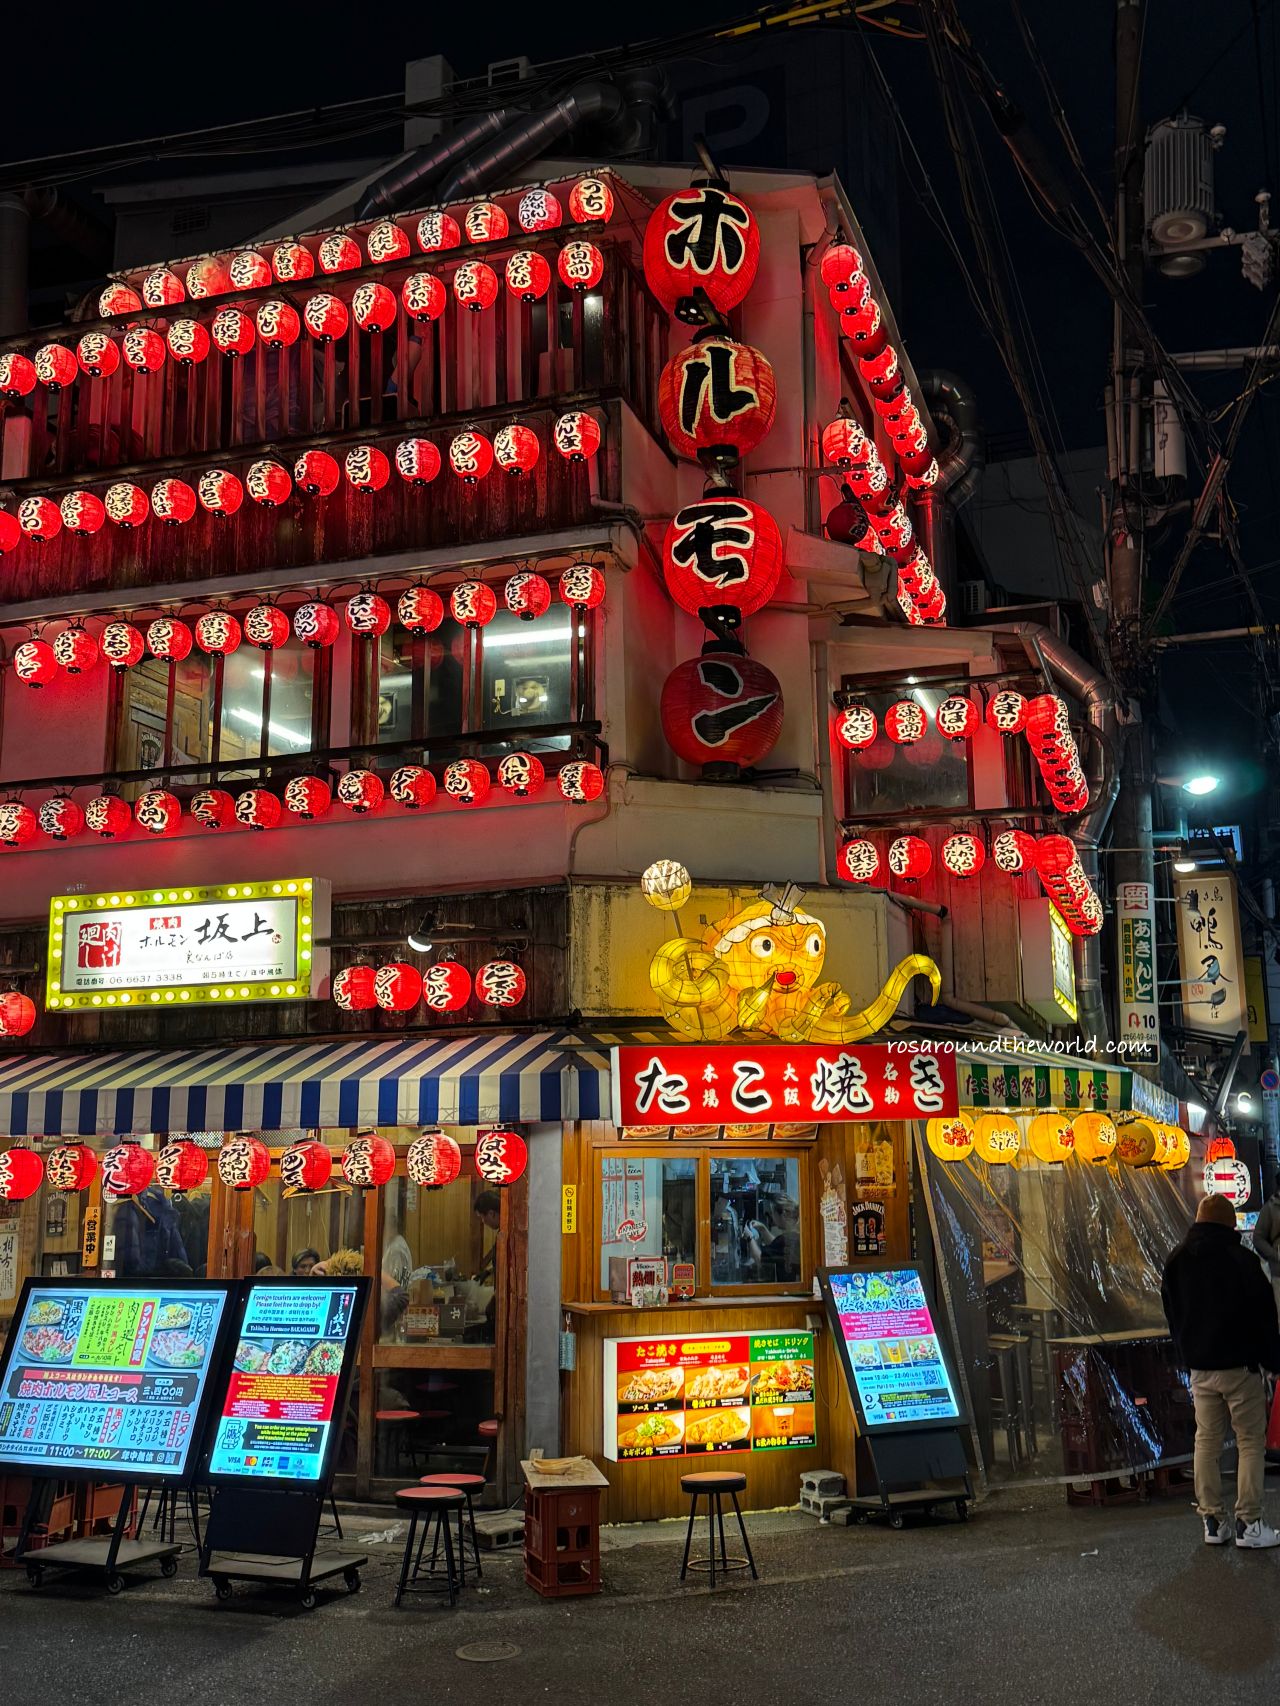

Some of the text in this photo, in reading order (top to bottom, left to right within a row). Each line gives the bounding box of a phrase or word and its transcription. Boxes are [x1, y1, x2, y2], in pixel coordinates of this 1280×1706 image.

[582, 180, 606, 213] うち
[939, 697, 968, 734] あほか
[1123, 886, 1149, 911] 質
[102, 922, 123, 967] 肉汁
[139, 934, 190, 949] ホルモン
[194, 912, 275, 945] 坂上
[1133, 920, 1153, 1001] あきんど
[109, 973, 183, 985] 06 6637 3338
[1143, 1014, 1156, 1029] 10
[634, 1052, 945, 1114] たこ焼き
[702, 1063, 720, 1108] 本場
[782, 1062, 801, 1107] 大阪
[883, 1062, 900, 1105] 名物
[965, 1074, 1110, 1101] たこ焼き祭り きしたこ
[103, 1147, 131, 1191] 芸人
[477, 1138, 511, 1181] はみご
[85, 1219, 97, 1255] 営業中
[253, 1295, 272, 1303] Foreign
[299, 1301, 311, 1310] drop
[193, 1302, 215, 1346] 白タレ
[636, 1344, 678, 1358] たこ焼き
[18, 1379, 138, 1403] 焼肉ホルモン坂上コース
[632, 1404, 650, 1412] ソース
[9, 1402, 26, 1437] 焼きそば
[106, 1407, 124, 1444] 黒タレ
[174, 1410, 191, 1448] 白タレ
[227, 1456, 241, 1464] VISA
[622, 1447, 654, 1458] ネギポン酢
